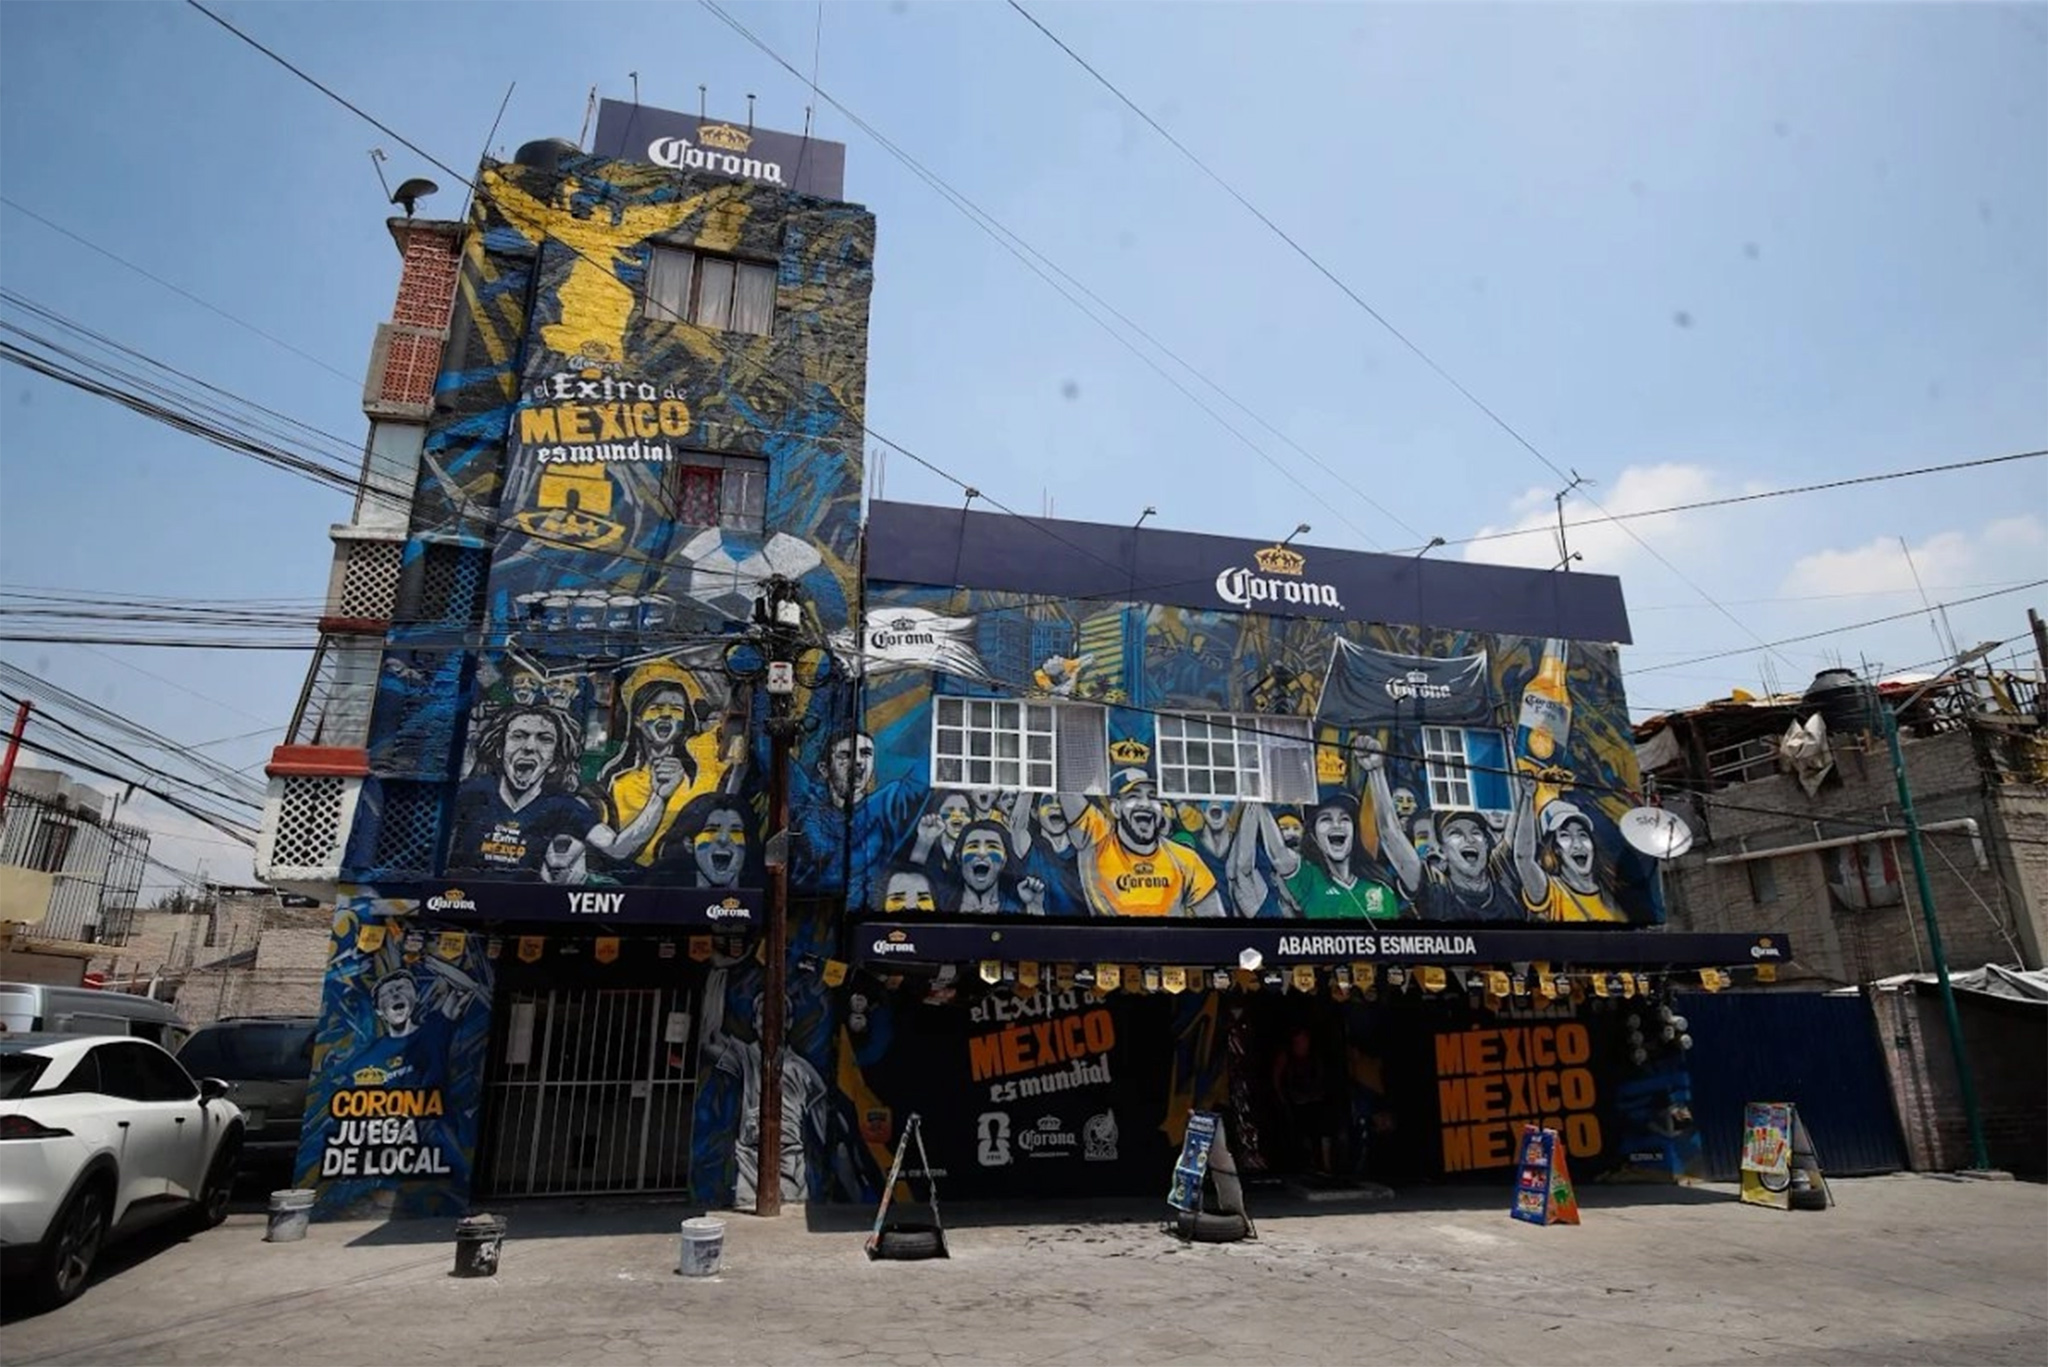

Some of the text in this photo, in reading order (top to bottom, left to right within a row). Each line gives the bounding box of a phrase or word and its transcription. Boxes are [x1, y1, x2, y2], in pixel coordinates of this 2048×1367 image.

[647, 136, 785, 186] Corona
[551, 372, 657, 401] Extra
[520, 399, 691, 444] MÉXICO
[1215, 567, 1345, 609] Corona
[871, 630, 934, 651] Corona
[1385, 677, 1452, 703] Corona
[1116, 873, 1170, 893] Corona
[427, 896, 477, 911] Corona
[568, 892, 625, 914] YENY
[706, 904, 751, 919] Corona
[873, 940, 916, 954] Corona
[1278, 936, 1476, 955] ABARROTES ESMERALDA
[969, 1008, 1116, 1083] MÉXICO
[1434, 1022, 1591, 1076] MÉXICO
[332, 1090, 443, 1117] CORONA
[328, 1117, 418, 1146] JUEGA
[1018, 1128, 1077, 1151] Corona
[322, 1146, 450, 1176] DE LOCAL
